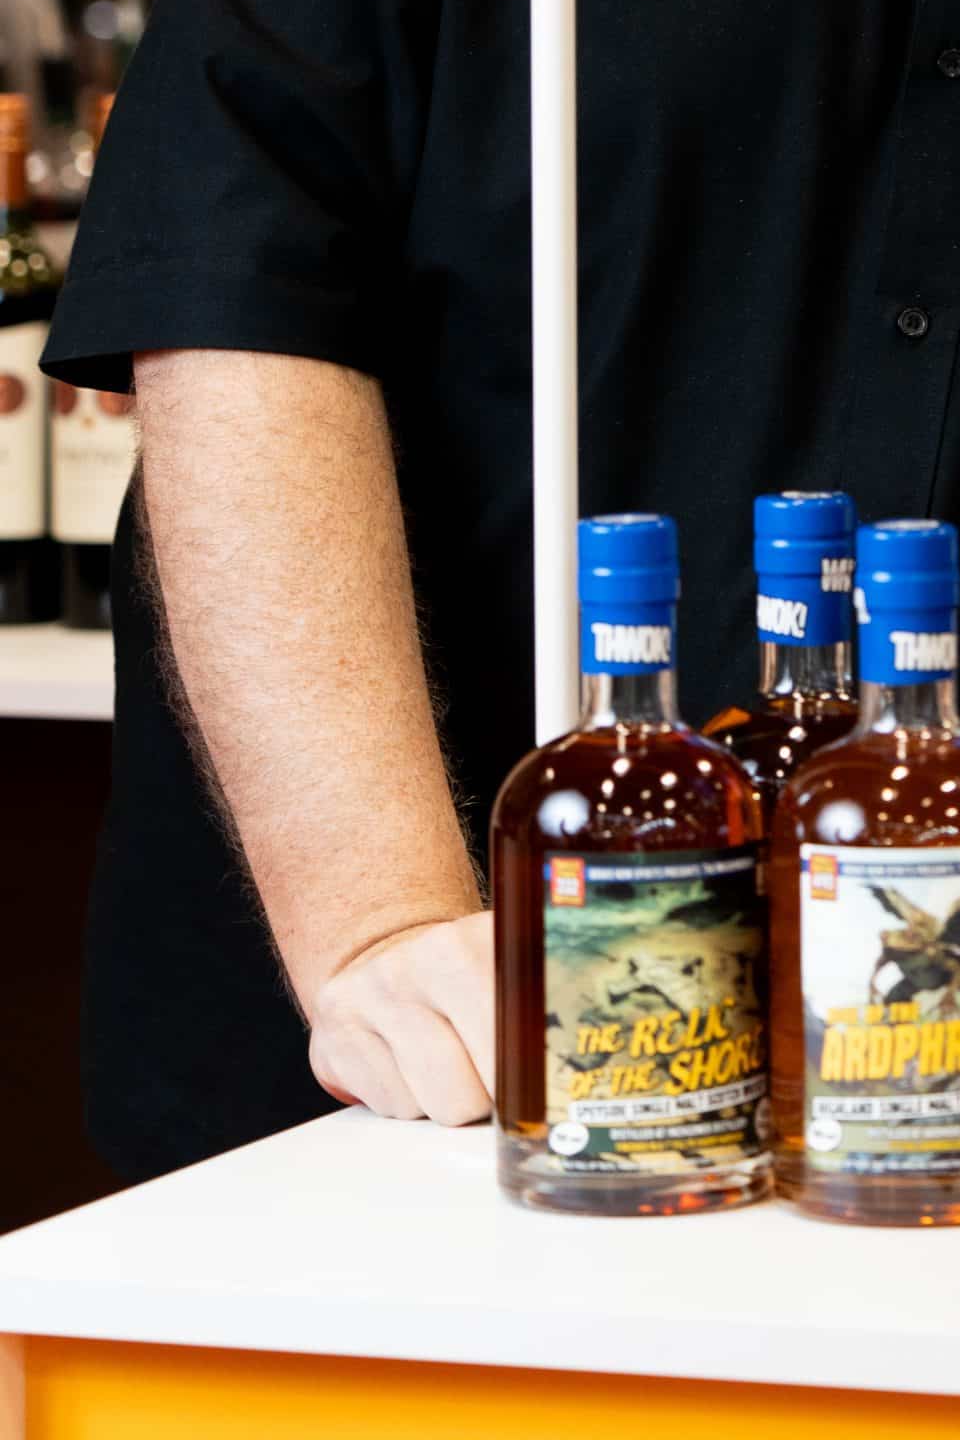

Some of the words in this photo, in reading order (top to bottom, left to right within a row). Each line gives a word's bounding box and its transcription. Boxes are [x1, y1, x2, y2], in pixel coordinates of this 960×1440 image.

[577, 1023, 624, 1056] THE
[570, 1068, 603, 1100] OF
[610, 1062, 659, 1096] THE
